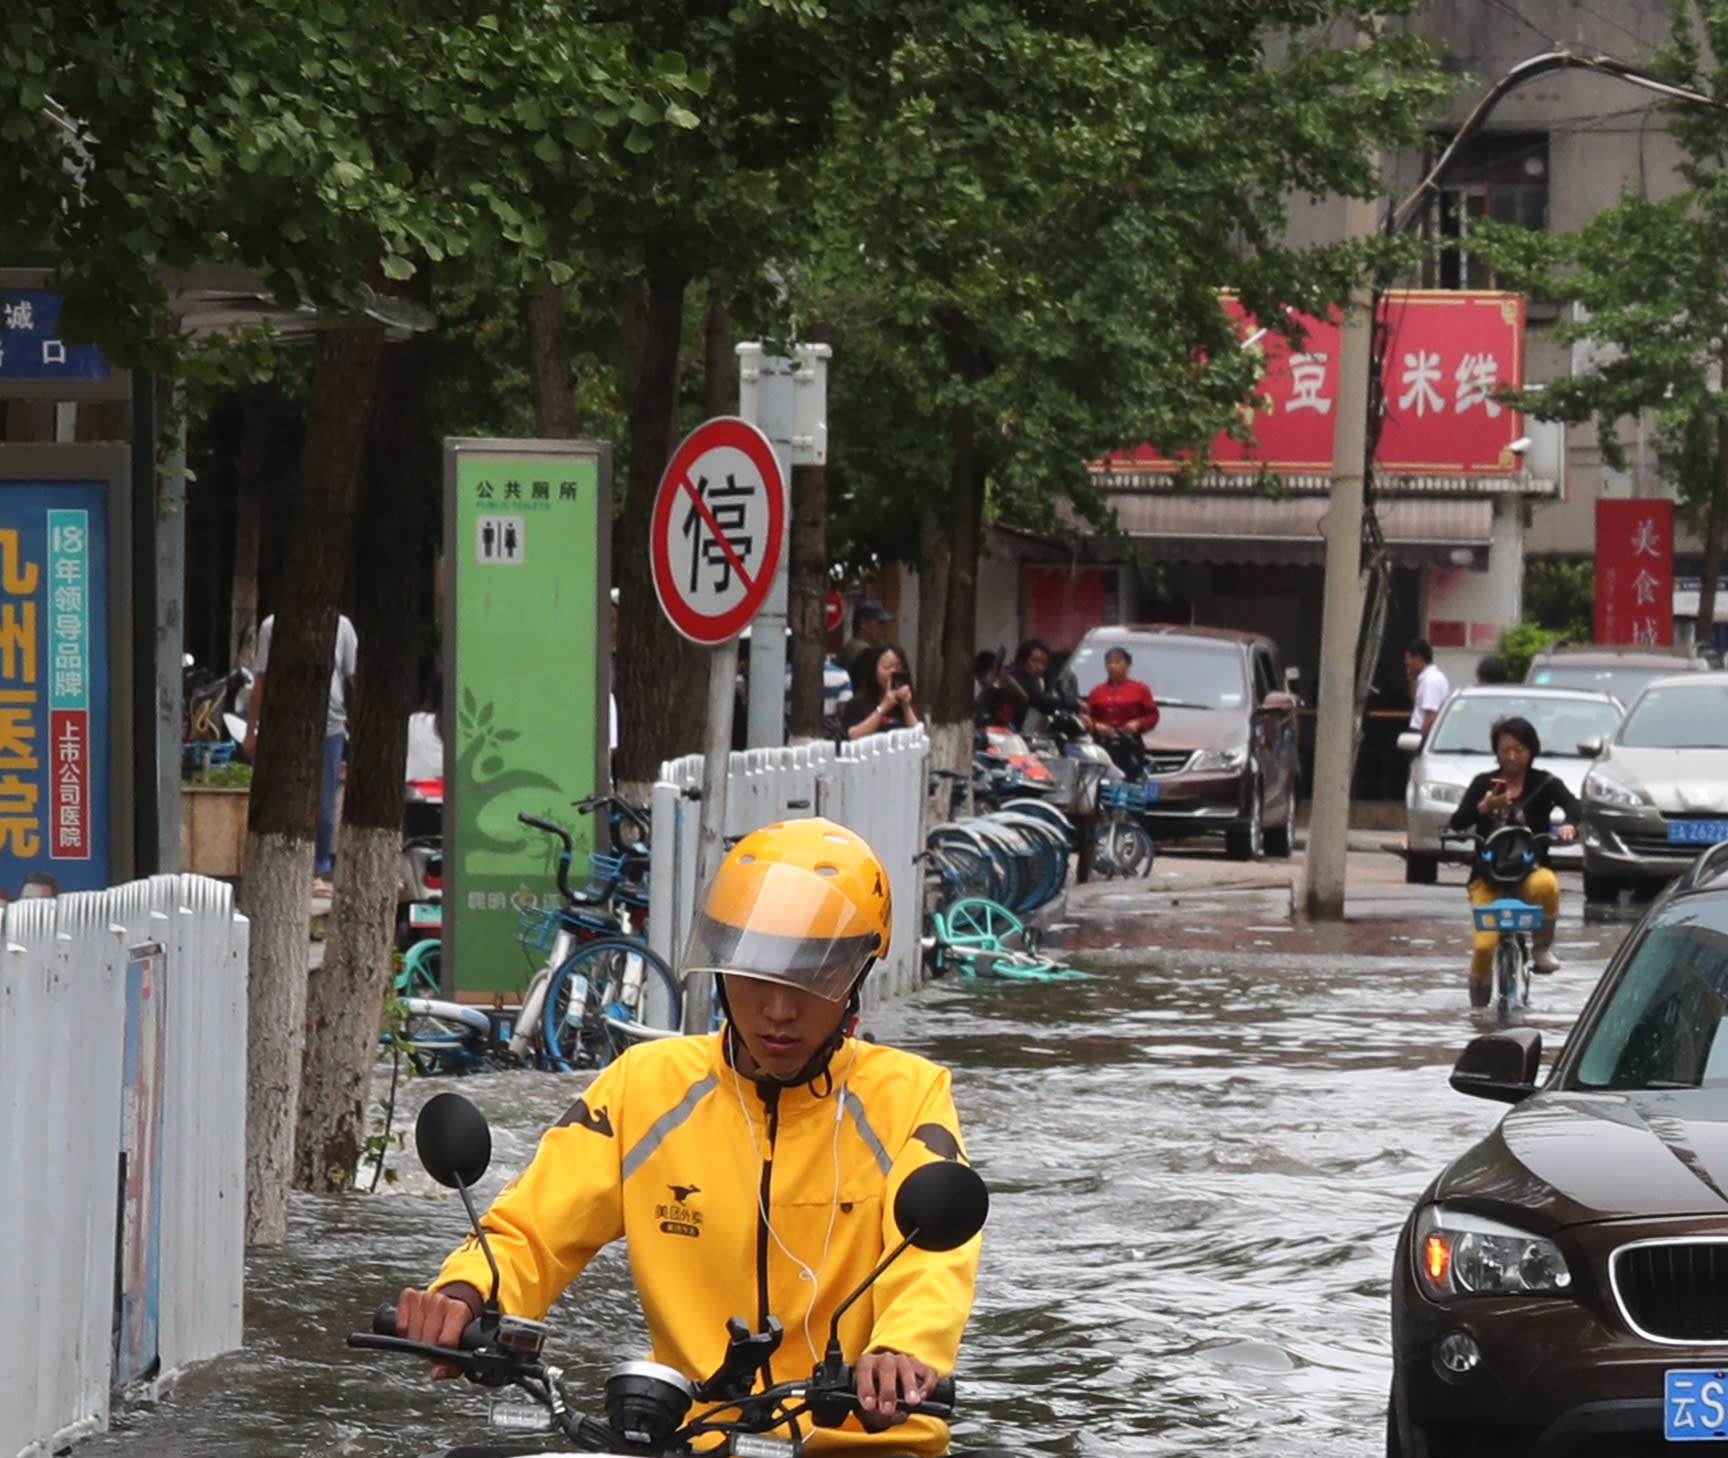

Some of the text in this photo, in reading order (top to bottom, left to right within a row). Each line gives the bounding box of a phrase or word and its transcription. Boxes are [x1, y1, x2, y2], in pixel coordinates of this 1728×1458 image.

[1285, 350, 1502, 419] 豆米线
[476, 480, 578, 500] 公共厕所
[682, 474, 755, 593] 停
[53, 526, 84, 697] 18年领导品牌
[59, 720, 82, 848] 上市公司医院
